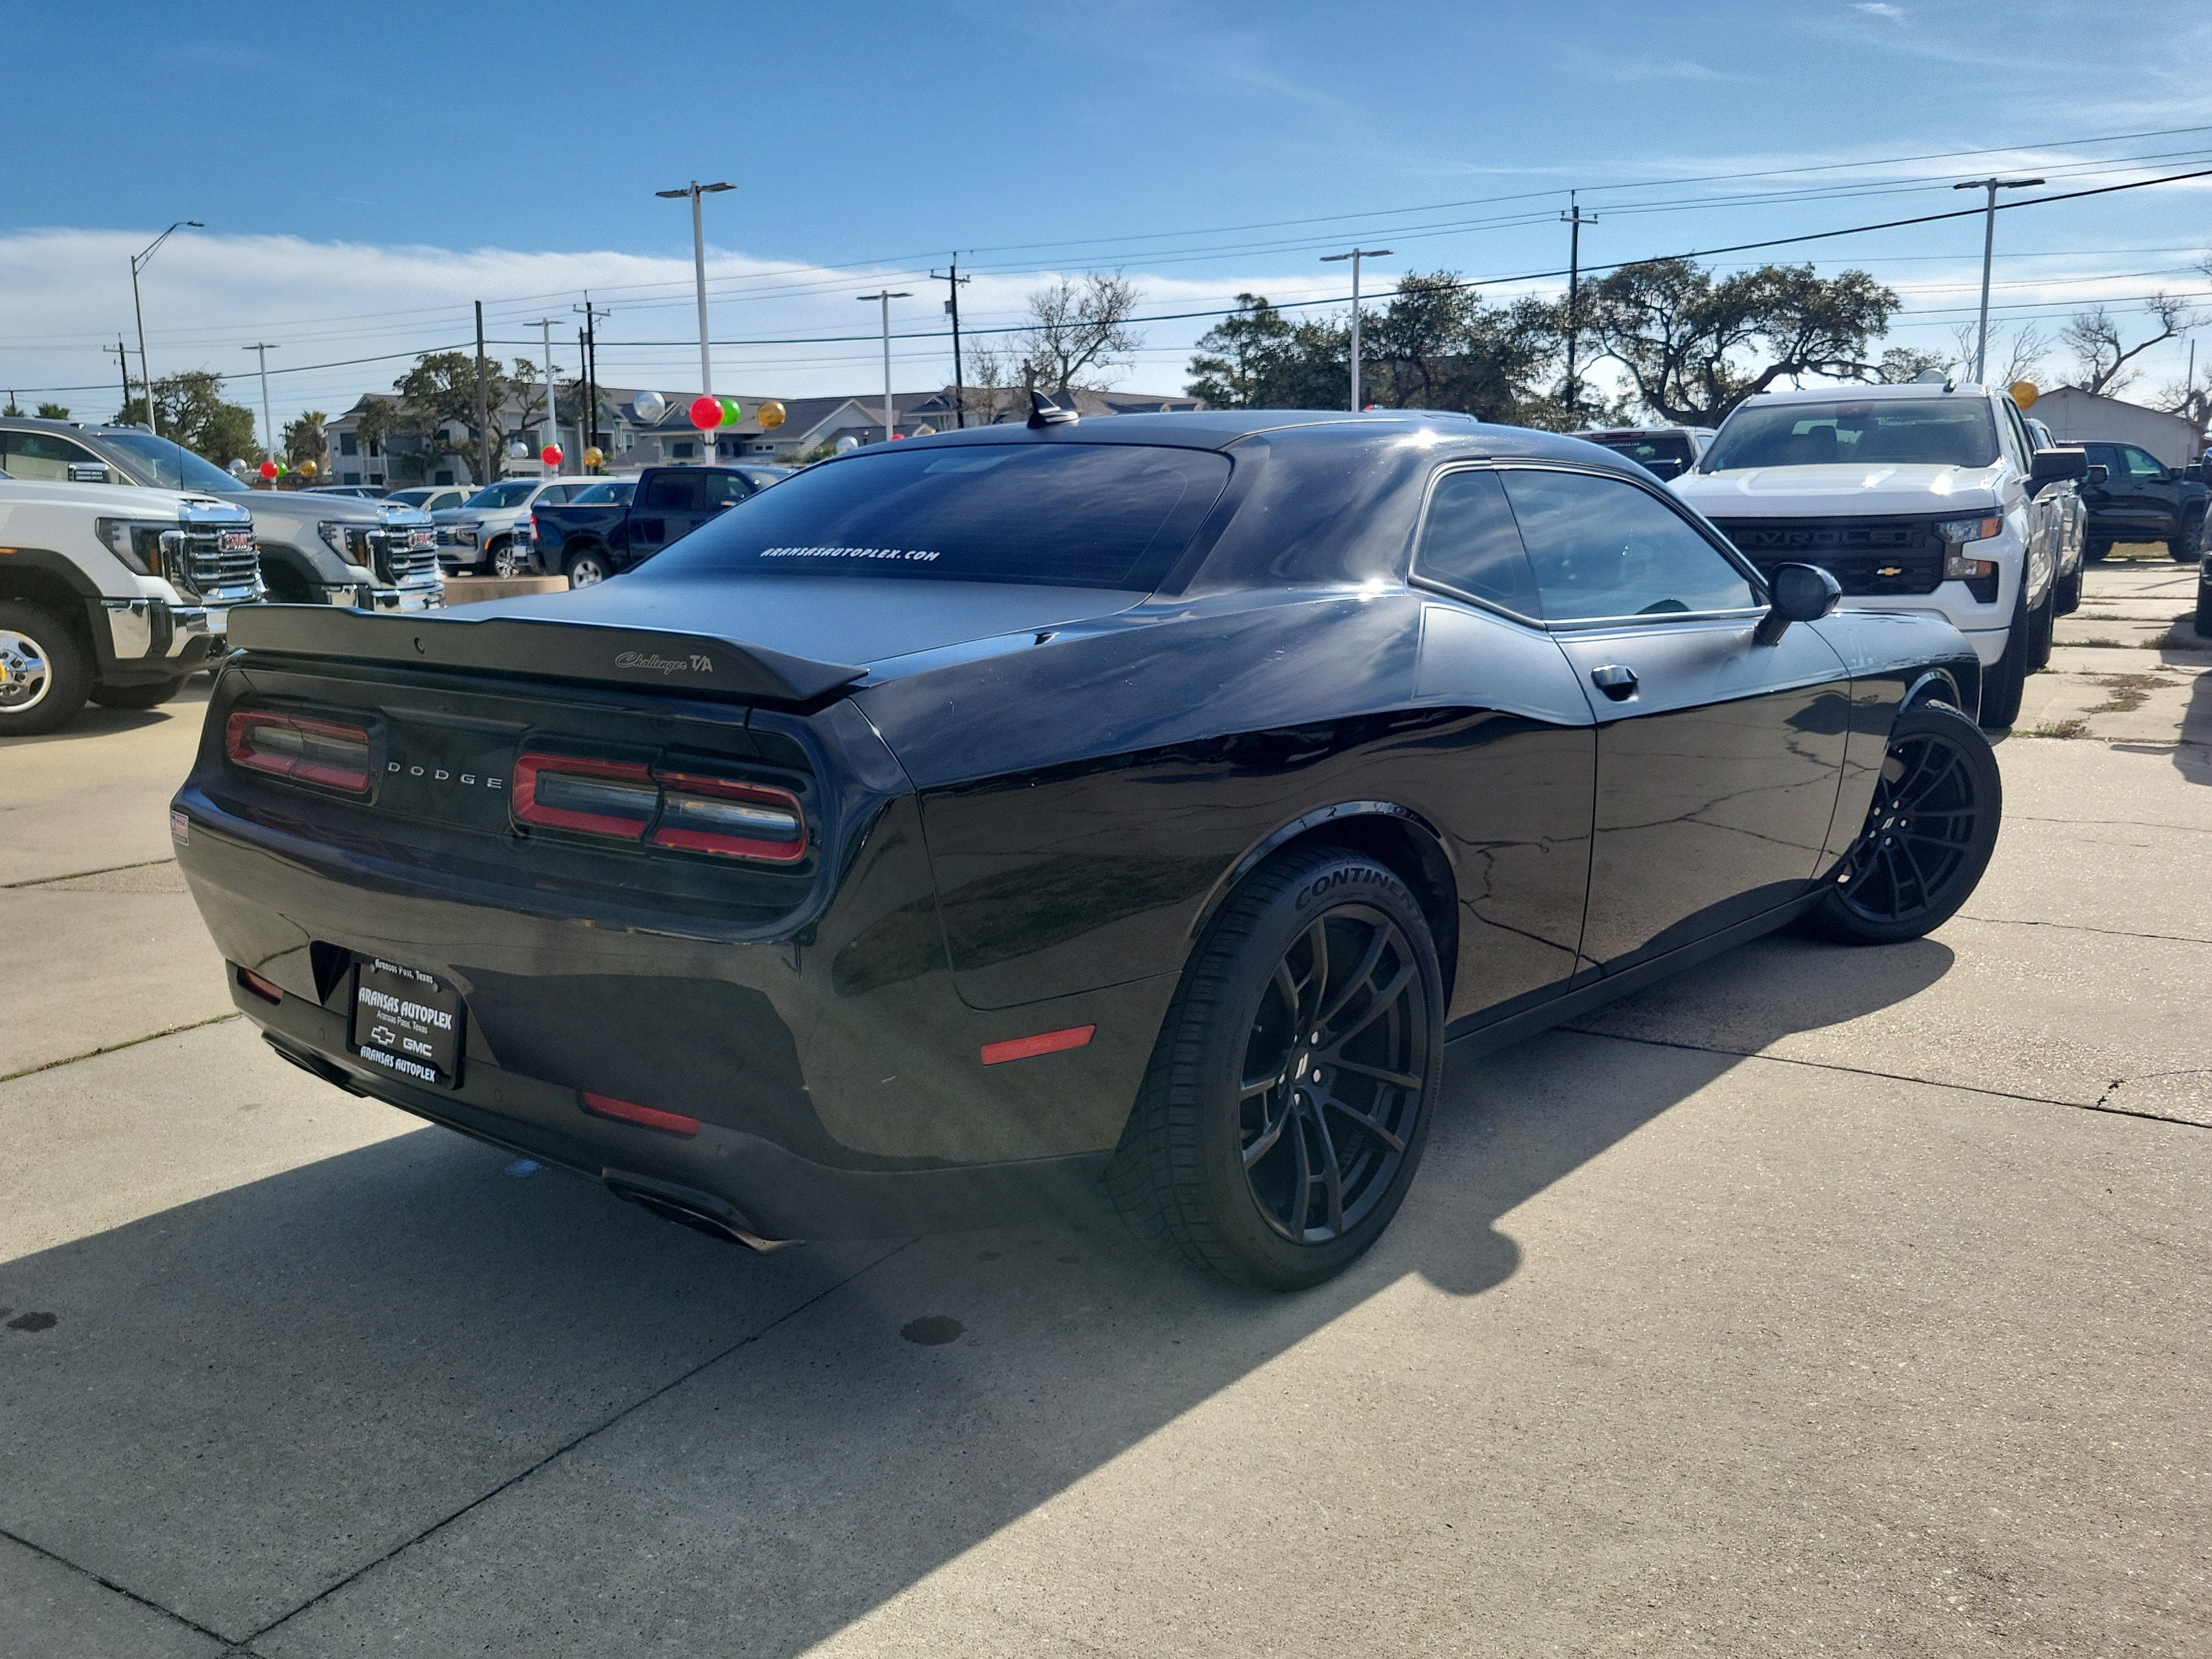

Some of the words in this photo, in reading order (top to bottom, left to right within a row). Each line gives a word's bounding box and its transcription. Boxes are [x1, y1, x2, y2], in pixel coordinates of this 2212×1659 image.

[760, 547, 941, 561] ARANSASAUTOPLEX.COM
[615, 651, 687, 675] Challenger
[388, 762, 503, 789] DODGE
[375, 958, 397, 974] Aransas
[415, 970, 433, 984] Texas
[359, 987, 399, 1013] ARANSAS
[400, 1001, 452, 1030] AUTOPLEX
[377, 1010, 396, 1024] Aransas
[413, 1021, 428, 1035] Texas
[403, 1037, 432, 1057] GMC
[361, 1045, 394, 1068] ARANSAS
[395, 1058, 436, 1083] AUTOPLEX
